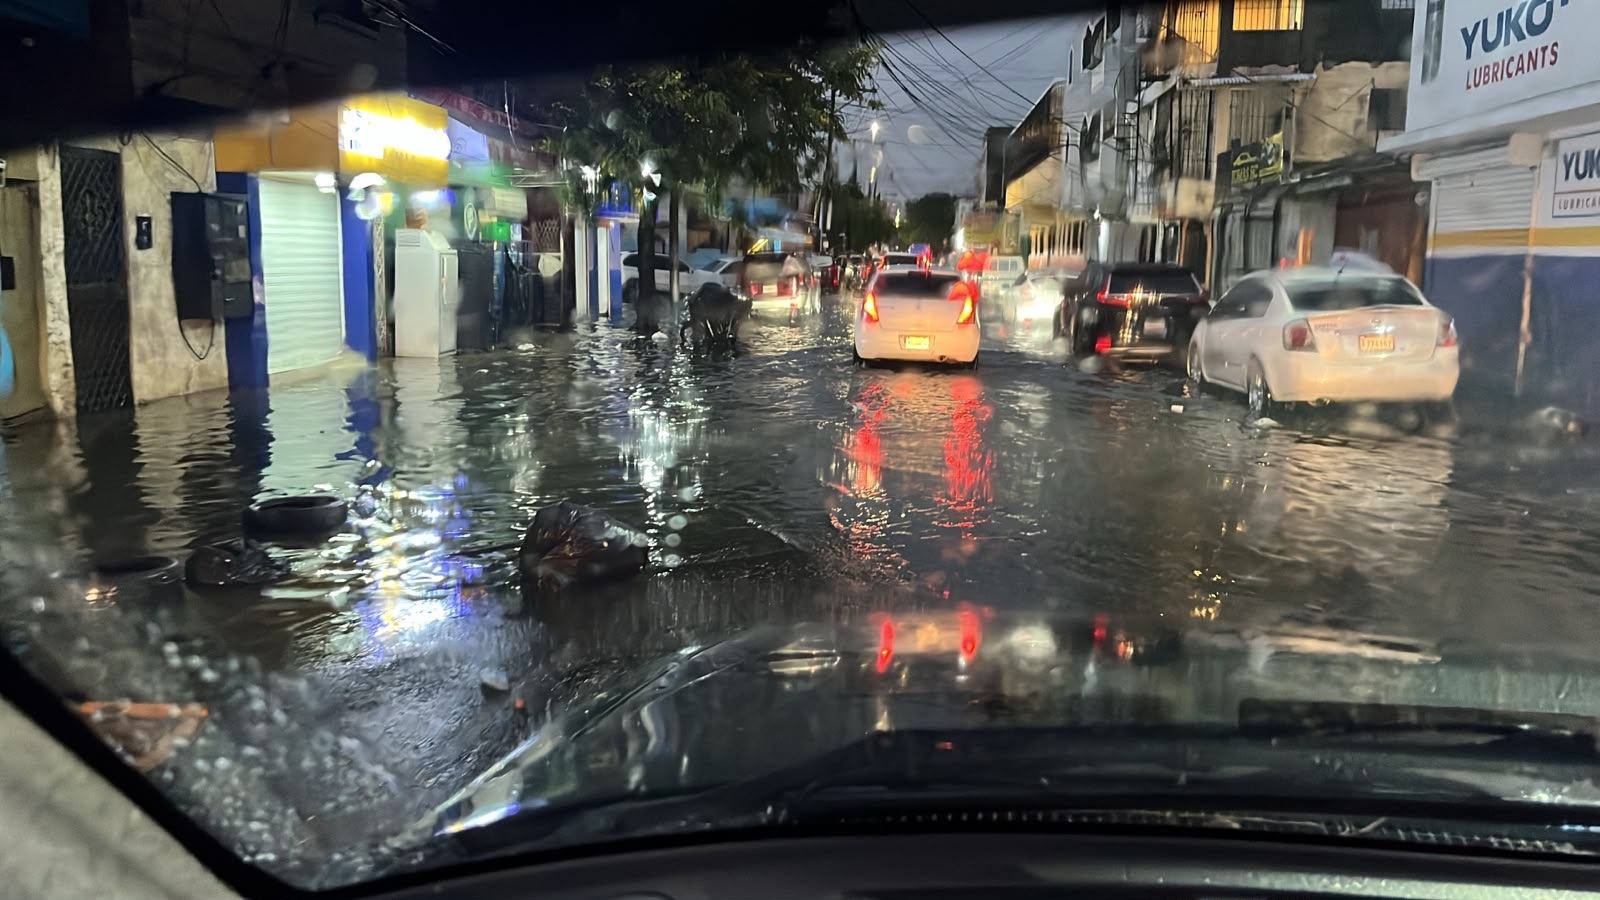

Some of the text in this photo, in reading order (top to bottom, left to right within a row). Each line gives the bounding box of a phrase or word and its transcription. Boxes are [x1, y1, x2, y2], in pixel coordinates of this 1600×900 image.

[1460, 0, 1569, 60] YUKO
[1466, 41, 1559, 91] LUBRICANTS
[1559, 197, 1600, 210] LUBRICA
